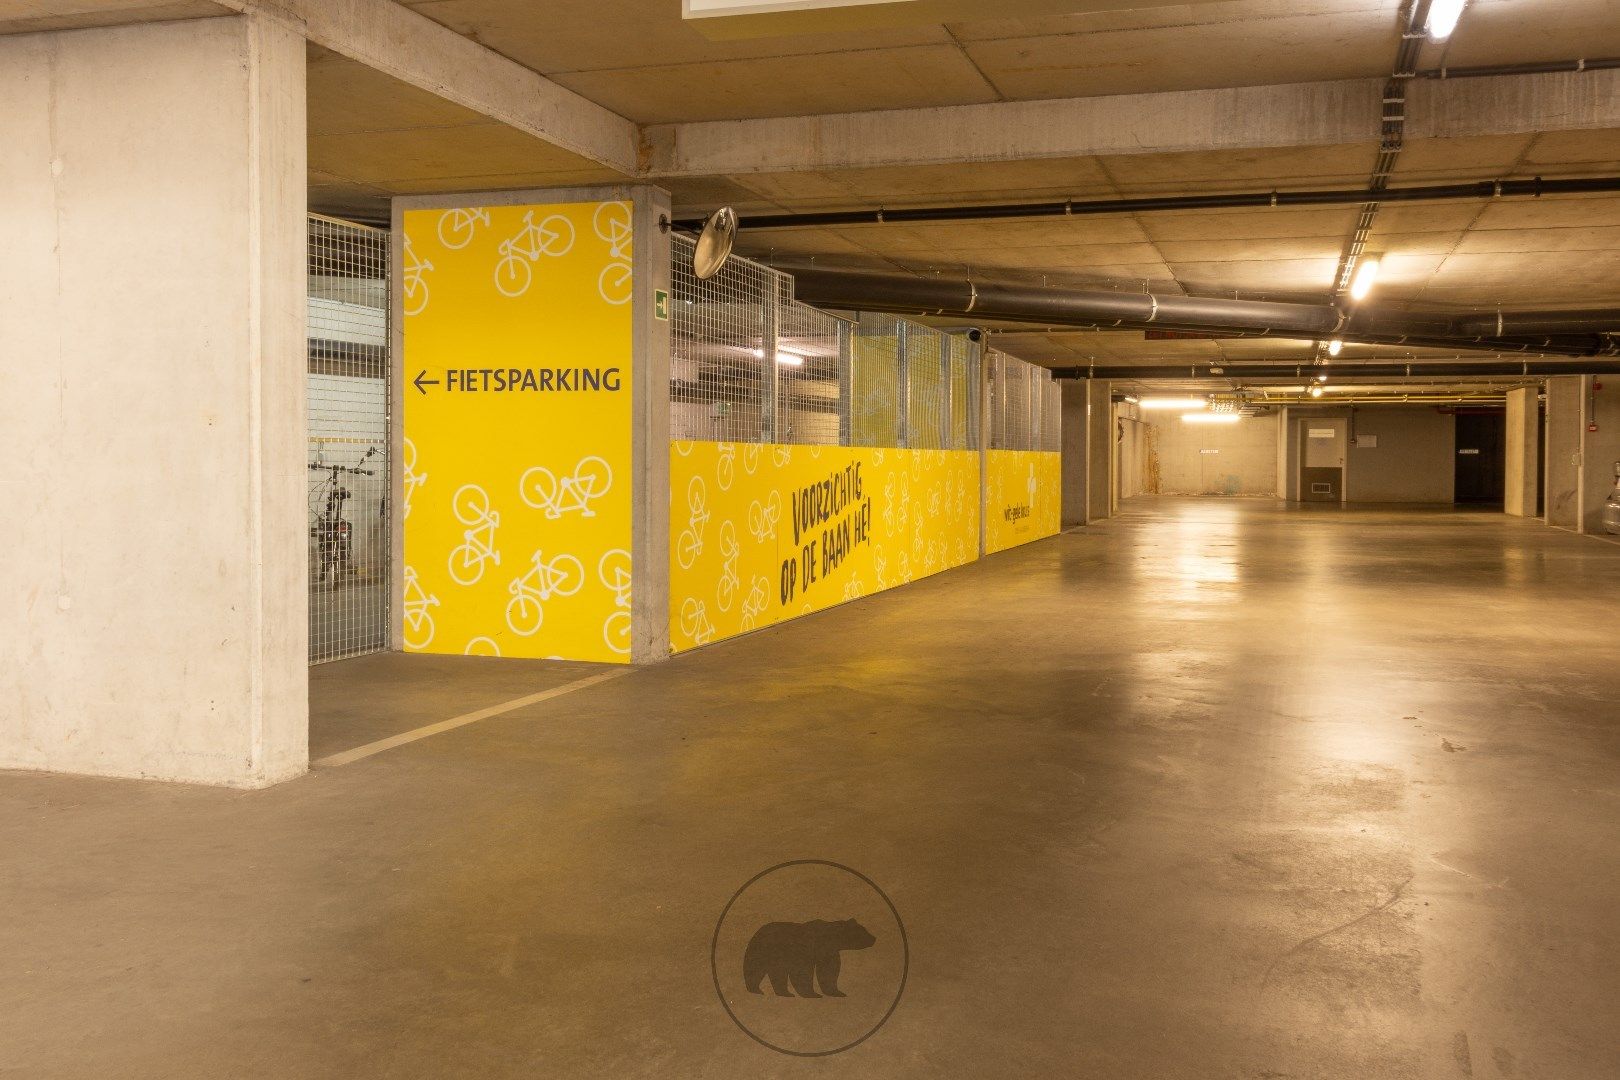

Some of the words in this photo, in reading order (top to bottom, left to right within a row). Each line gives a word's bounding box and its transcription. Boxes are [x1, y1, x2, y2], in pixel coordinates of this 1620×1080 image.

[446, 367, 621, 392] FIETSPARKING
[780, 557, 797, 606] OP
[802, 540, 817, 594] DE
[822, 514, 850, 579] BAAN
